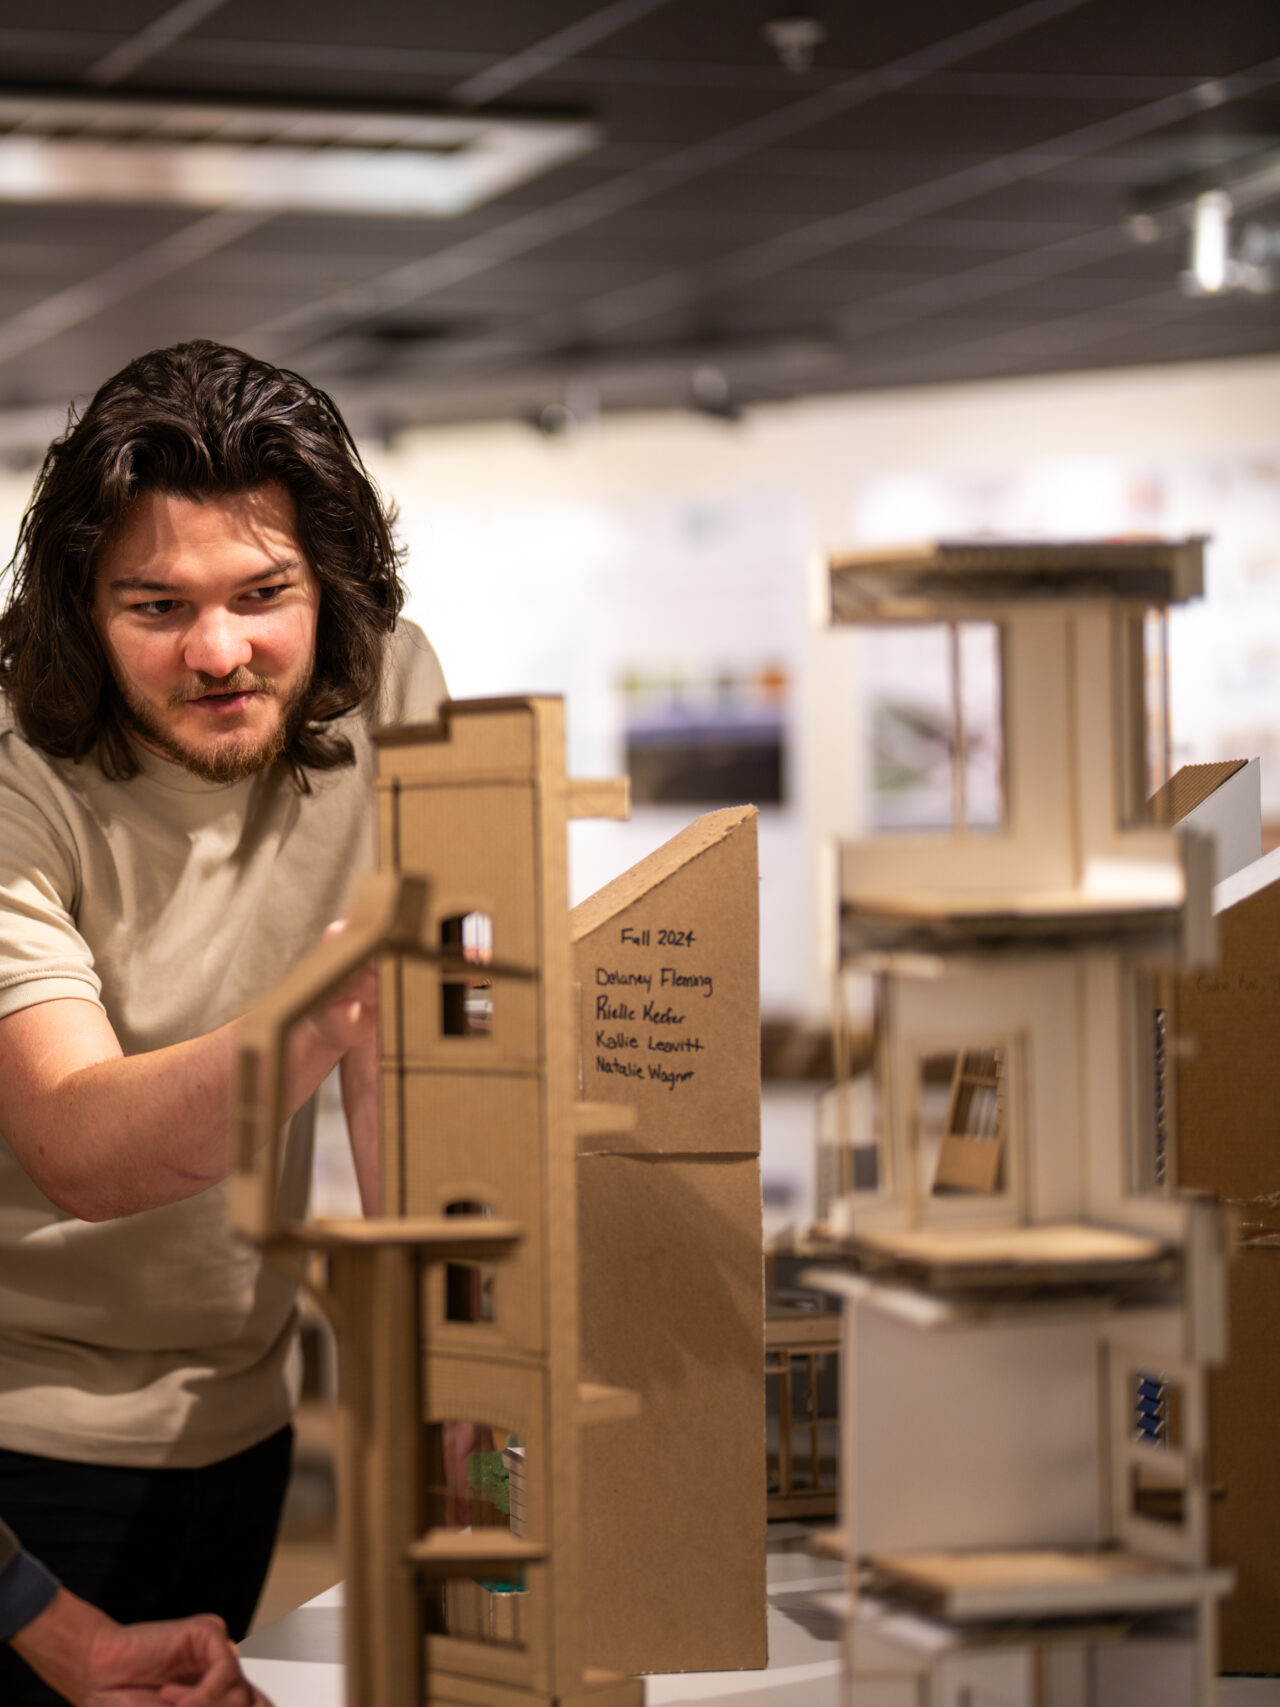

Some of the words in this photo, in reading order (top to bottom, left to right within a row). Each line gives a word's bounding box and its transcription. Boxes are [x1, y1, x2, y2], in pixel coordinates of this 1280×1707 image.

[621, 928, 650, 946] Fall
[658, 930, 696, 947] 2024
[596, 968, 652, 993] Delaney
[660, 968, 713, 998] Fleming
[595, 1030, 639, 1050] Kallie
[595, 1056, 645, 1080] Natalie
